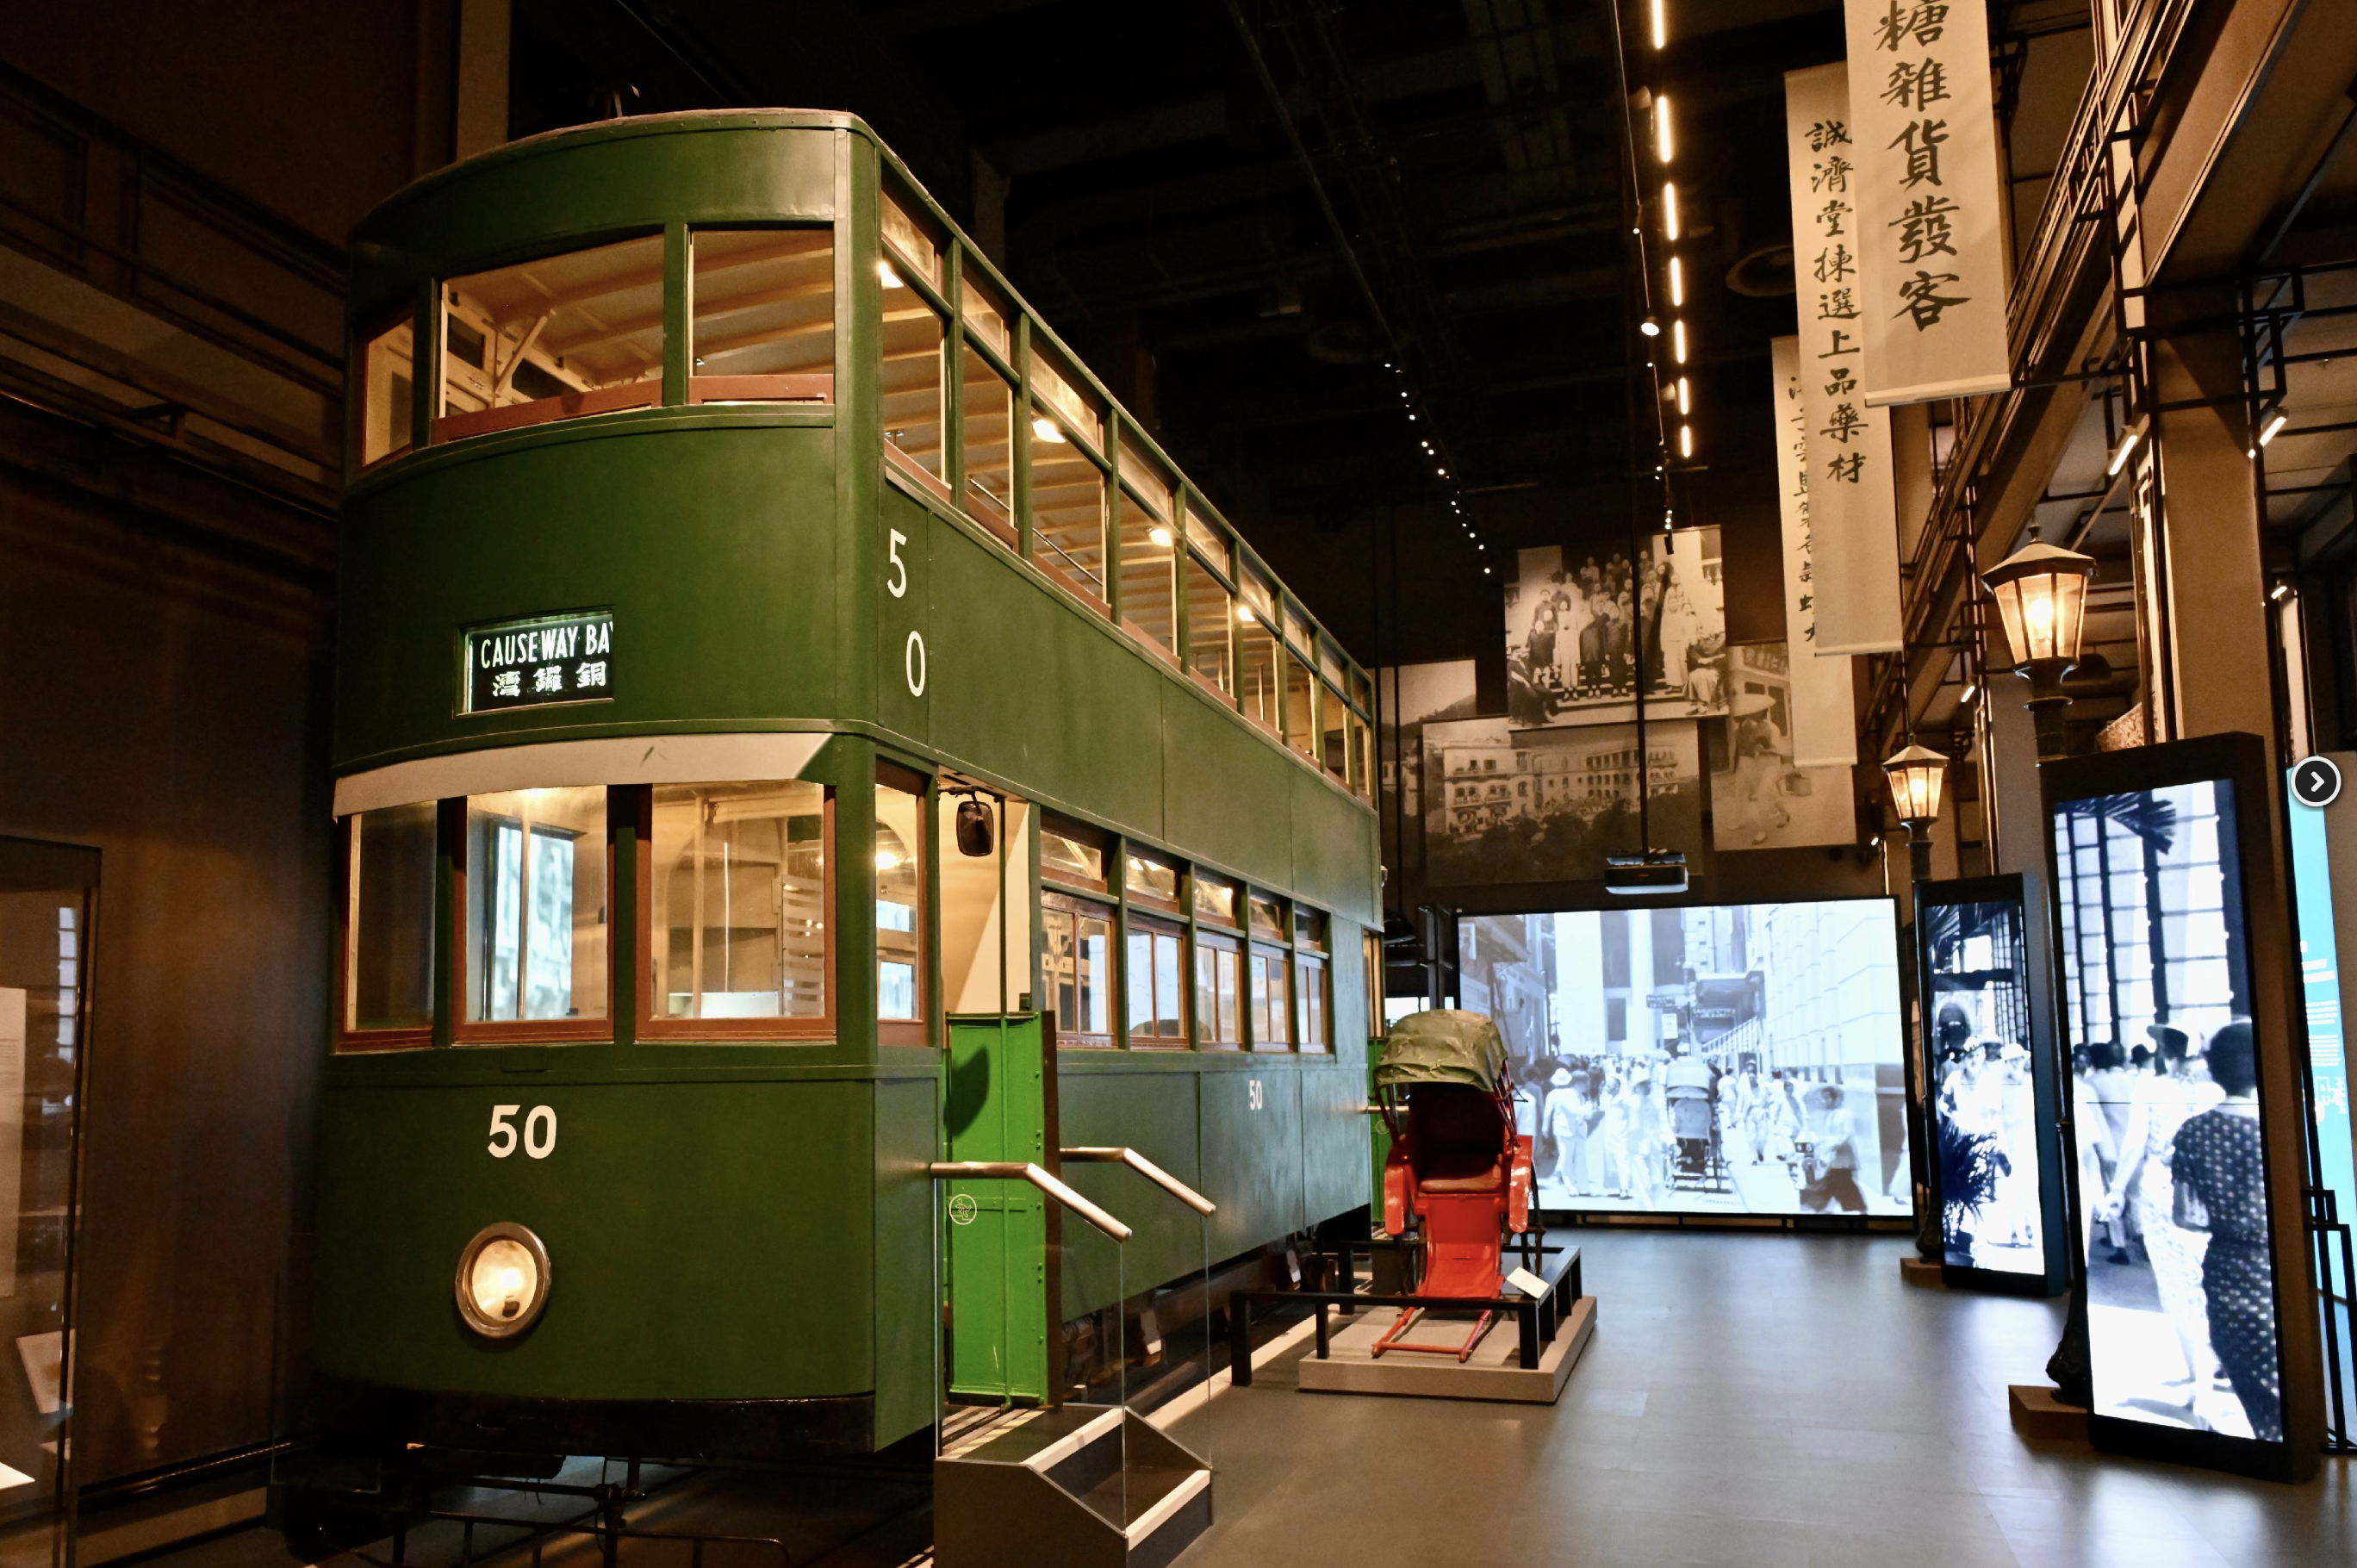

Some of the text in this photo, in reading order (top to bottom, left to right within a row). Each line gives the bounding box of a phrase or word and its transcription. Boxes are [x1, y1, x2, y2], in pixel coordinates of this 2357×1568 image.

[481, 621, 613, 669] CAUSEWAY BA
[1248, 1080, 1263, 1111] 50
[487, 1104, 557, 1159] 50
